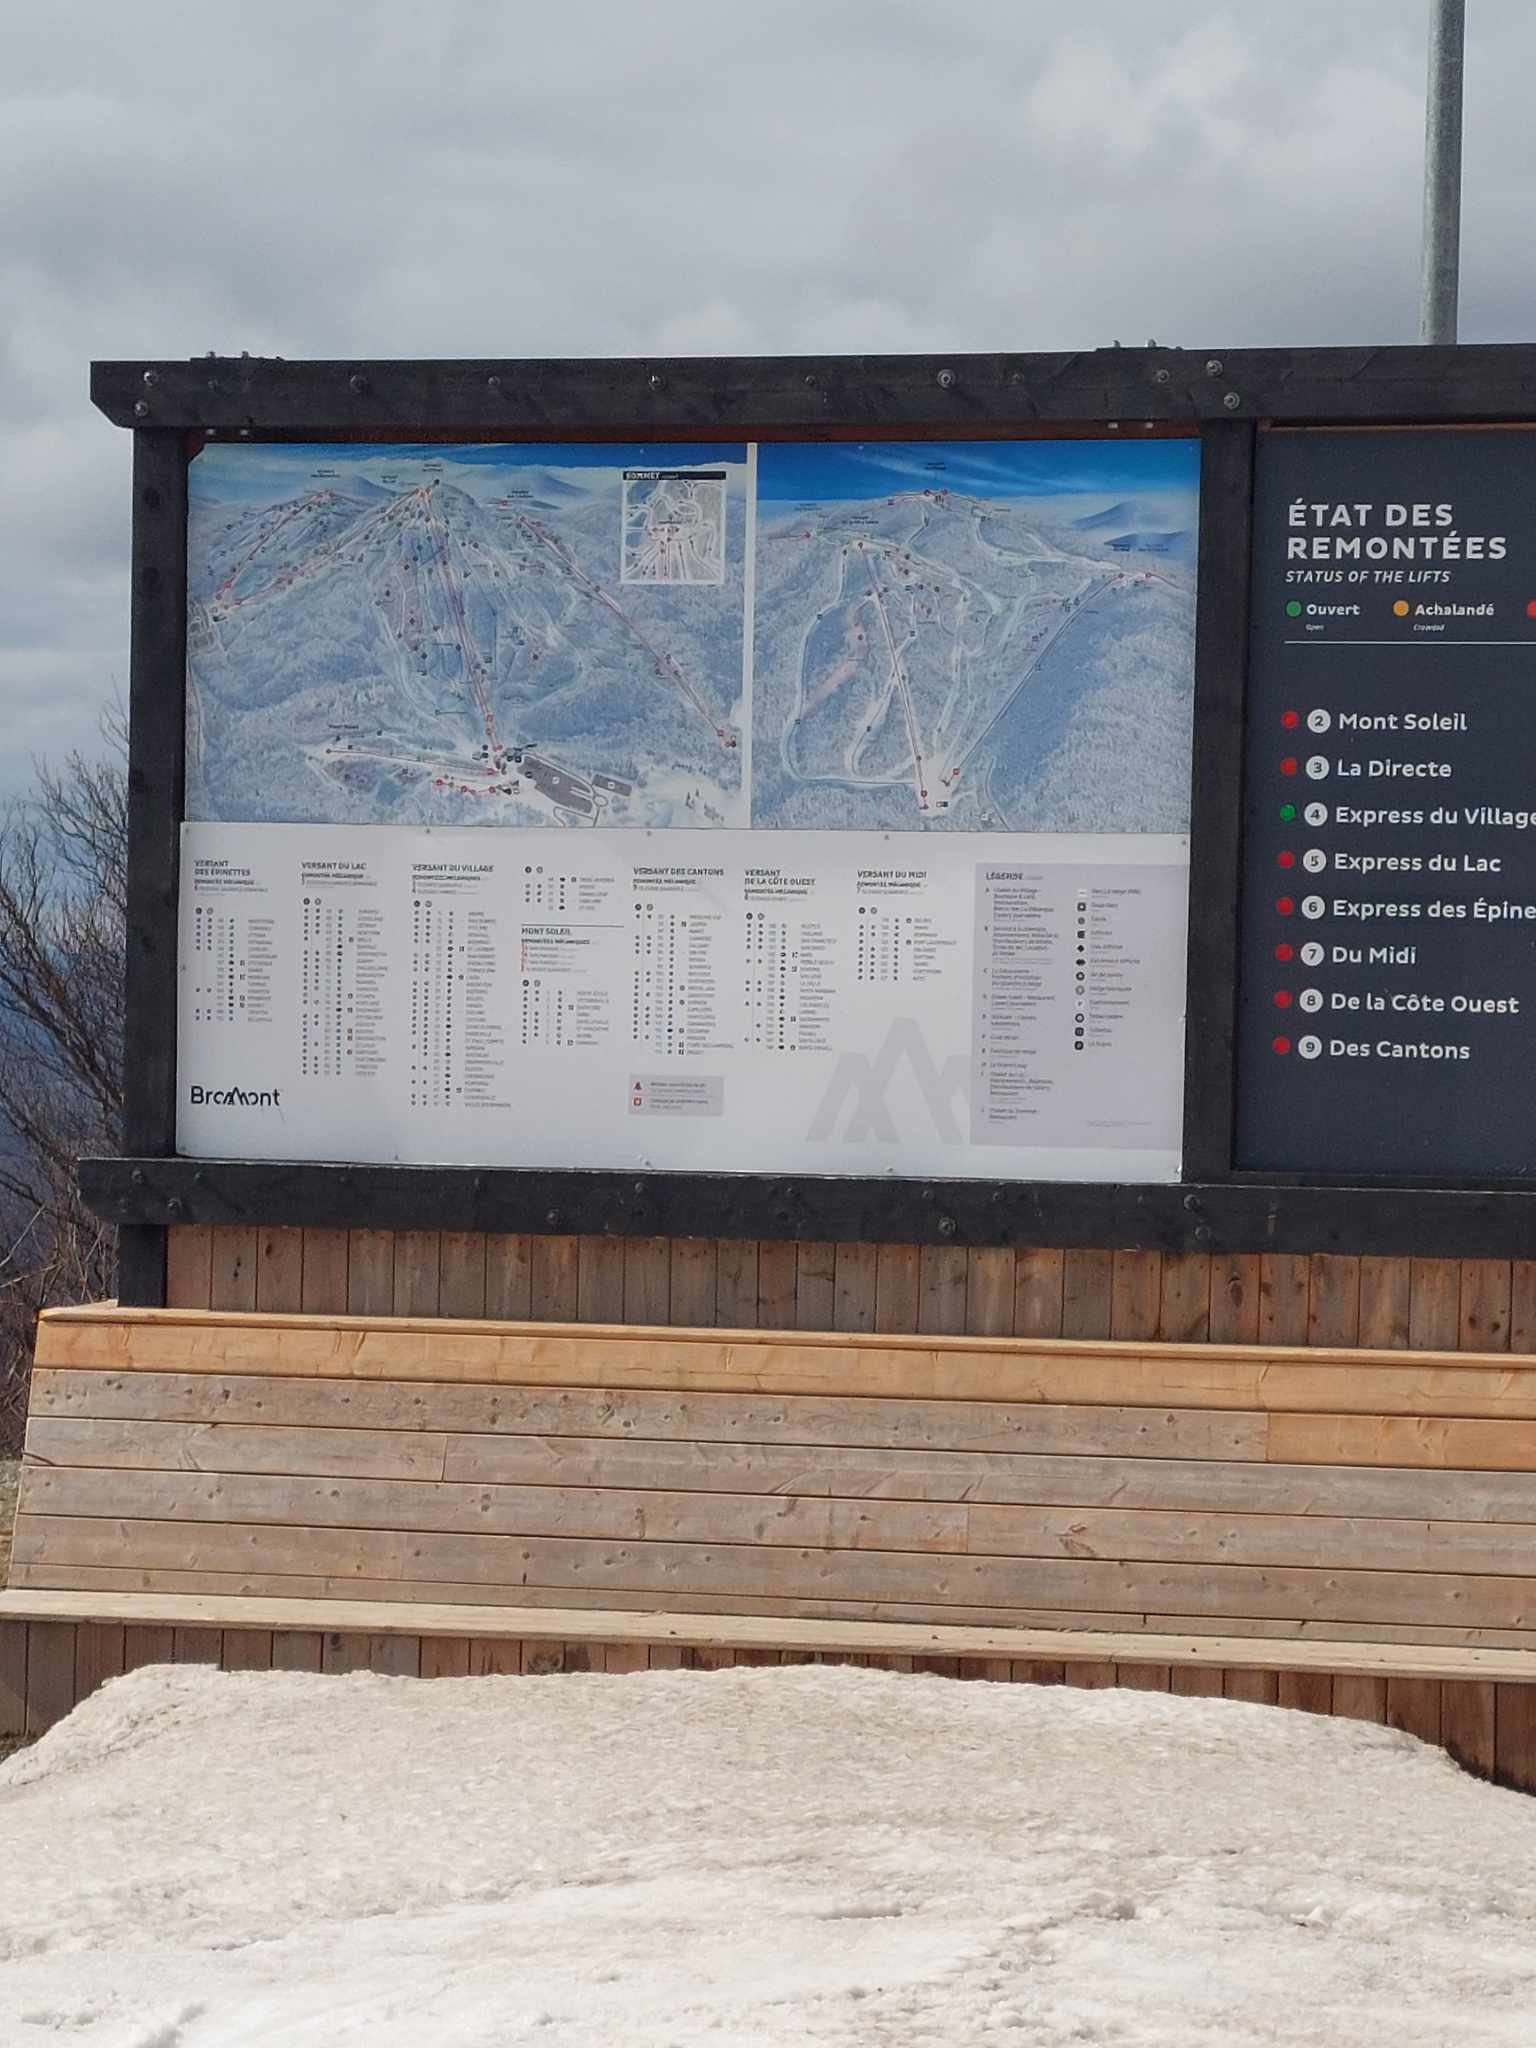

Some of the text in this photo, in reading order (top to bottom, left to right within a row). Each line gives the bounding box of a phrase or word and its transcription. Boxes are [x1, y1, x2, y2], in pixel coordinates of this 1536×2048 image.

[1288, 497, 1453, 527] ÉTAT DES
[1287, 530, 1507, 560] REMONTÉES
[1285, 570, 1451, 584] STATUS OF THE LIFTS
[1306, 603, 1361, 616] Ouvert
[1414, 602, 1495, 616] Achalandé
[1339, 712, 1399, 730] Mont
[1403, 712, 1468, 731] Soleil
[1337, 759, 1362, 777] La
[1368, 758, 1452, 778] Directe
[1335, 806, 1424, 828] Express
[1429, 806, 1458, 825] du
[302, 862, 337, 870] VERSANT
[351, 863, 367, 871] LAC
[633, 867, 669, 875] VERSANT
[687, 868, 724, 876] CANTONS
[1334, 852, 1423, 875] Express
[1428, 853, 1457, 872] du
[1463, 854, 1502, 873] Lac
[857, 870, 894, 878] VERSANT
[1333, 899, 1422, 921] Express
[1427, 900, 1467, 919] des
[1332, 946, 1362, 963] Du
[1368, 945, 1417, 965] Midi
[1331, 992, 1361, 1010] De
[1366, 992, 1385, 1011] la
[1391, 993, 1445, 1012] Côte
[1450, 995, 1520, 1014] Ouest
[1329, 1039, 1371, 1057] Des
[1376, 1040, 1471, 1060] Cantons
